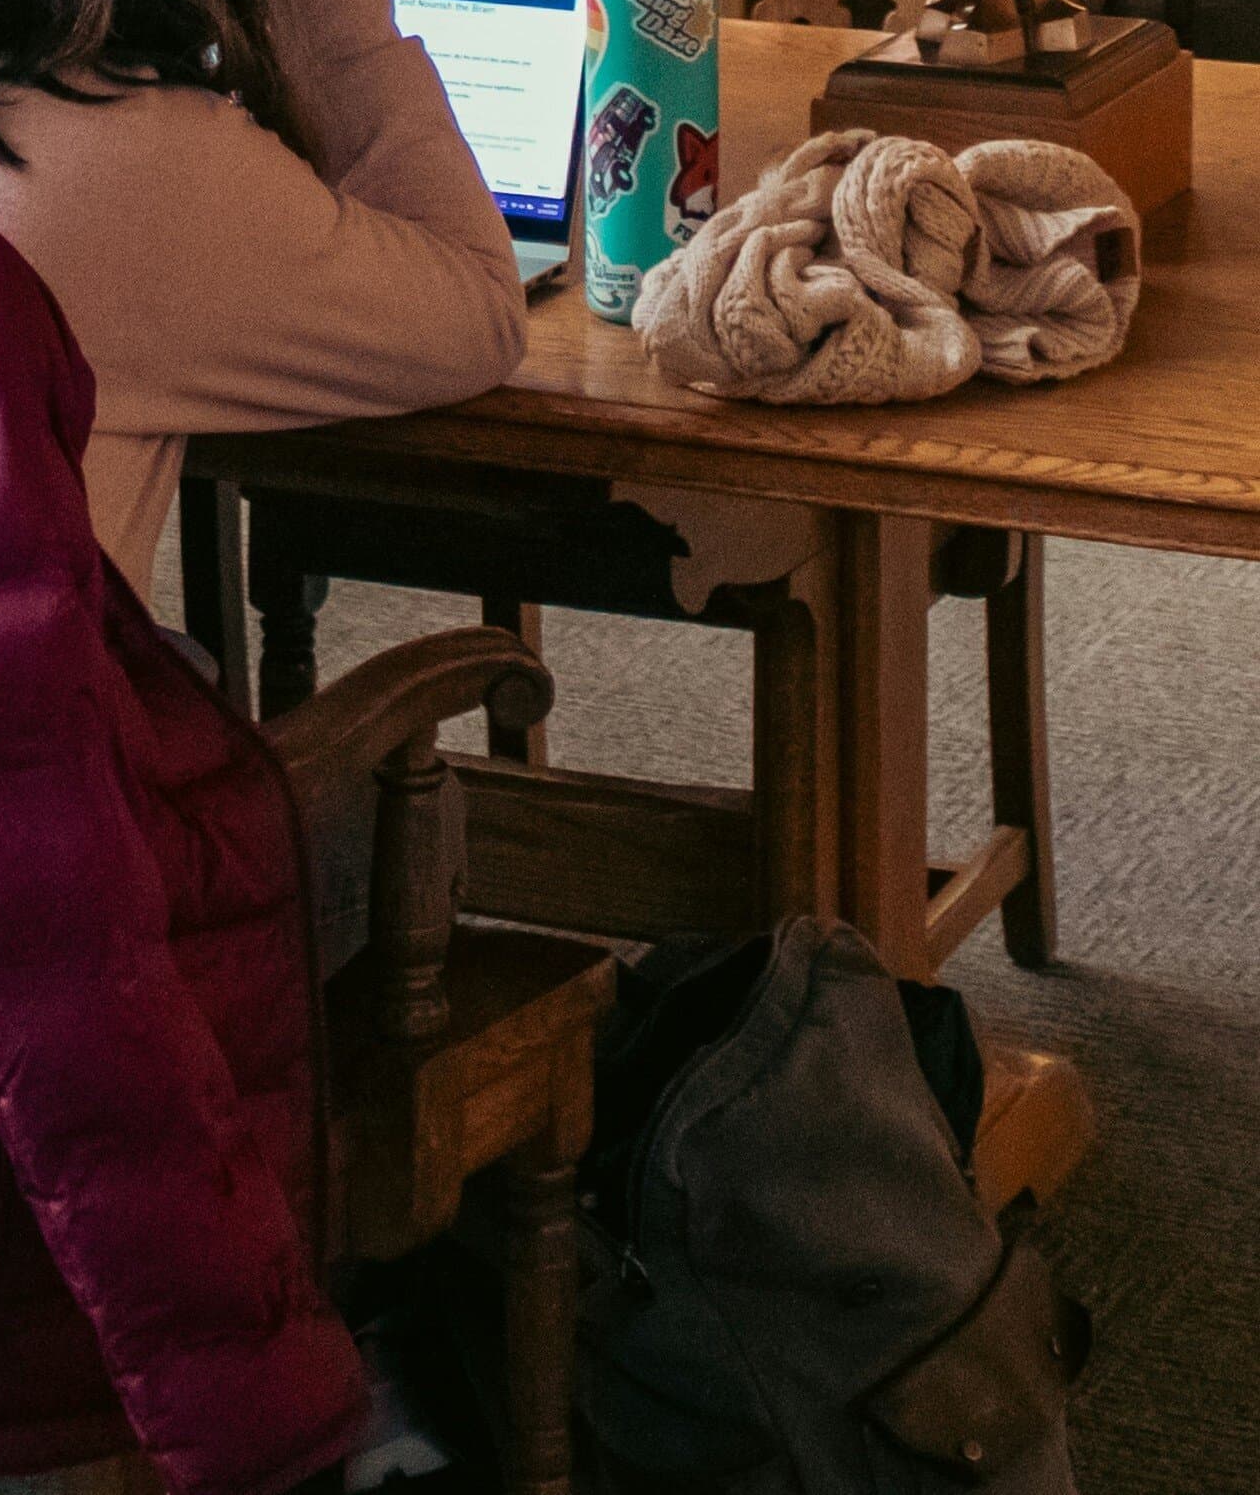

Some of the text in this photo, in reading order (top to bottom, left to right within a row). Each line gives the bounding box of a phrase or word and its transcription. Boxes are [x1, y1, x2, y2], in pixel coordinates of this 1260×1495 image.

[418, 0, 451, 9] Nourish
[455, 3, 469, 12] the
[471, 4, 496, 13] Brain
[637, 11, 700, 57] Daze
[672, 223, 697, 241] FO
